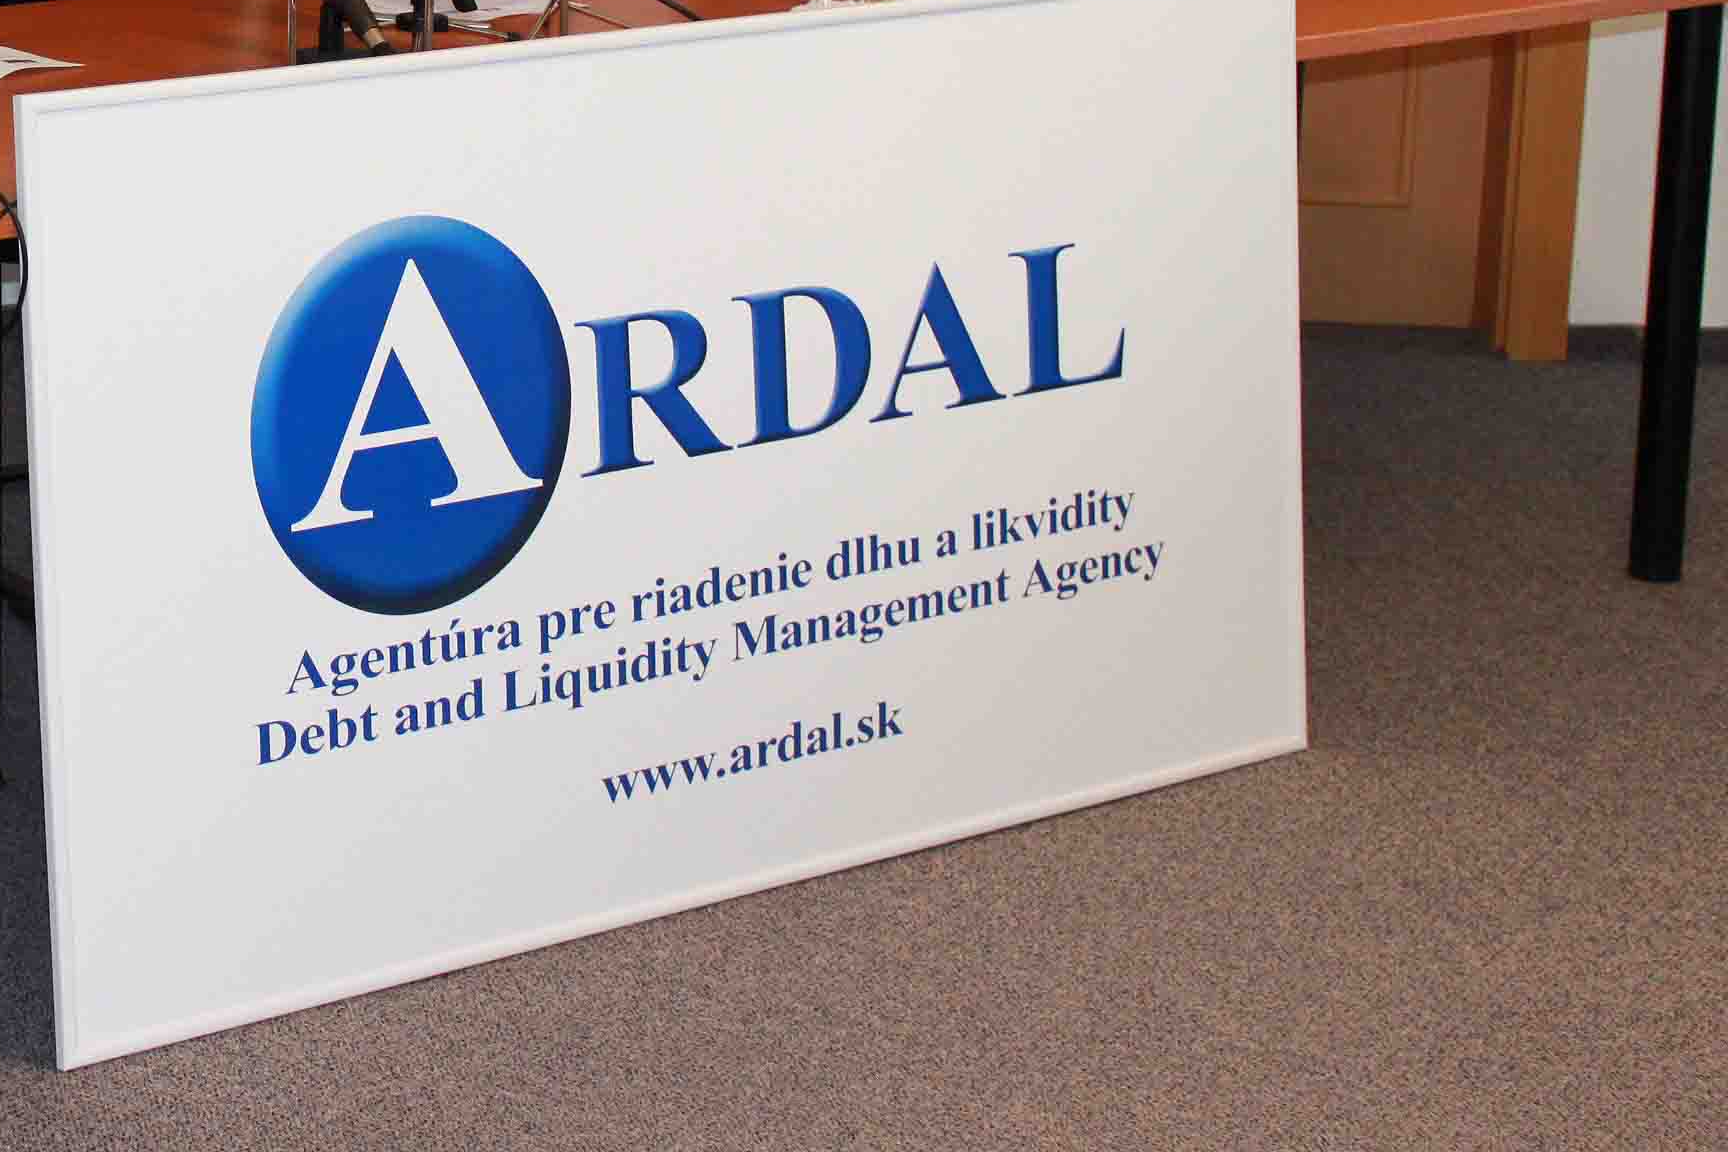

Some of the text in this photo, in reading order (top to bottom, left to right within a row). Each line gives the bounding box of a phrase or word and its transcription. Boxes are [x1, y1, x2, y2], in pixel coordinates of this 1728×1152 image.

[290, 242, 1126, 533] ARDAL
[255, 540, 1165, 767] Debt and Liquidity Management Agency
[286, 488, 1136, 697] Agentúra pre riadenie dlhu a likvidity
[601, 700, 904, 805] www.ardal.sk
